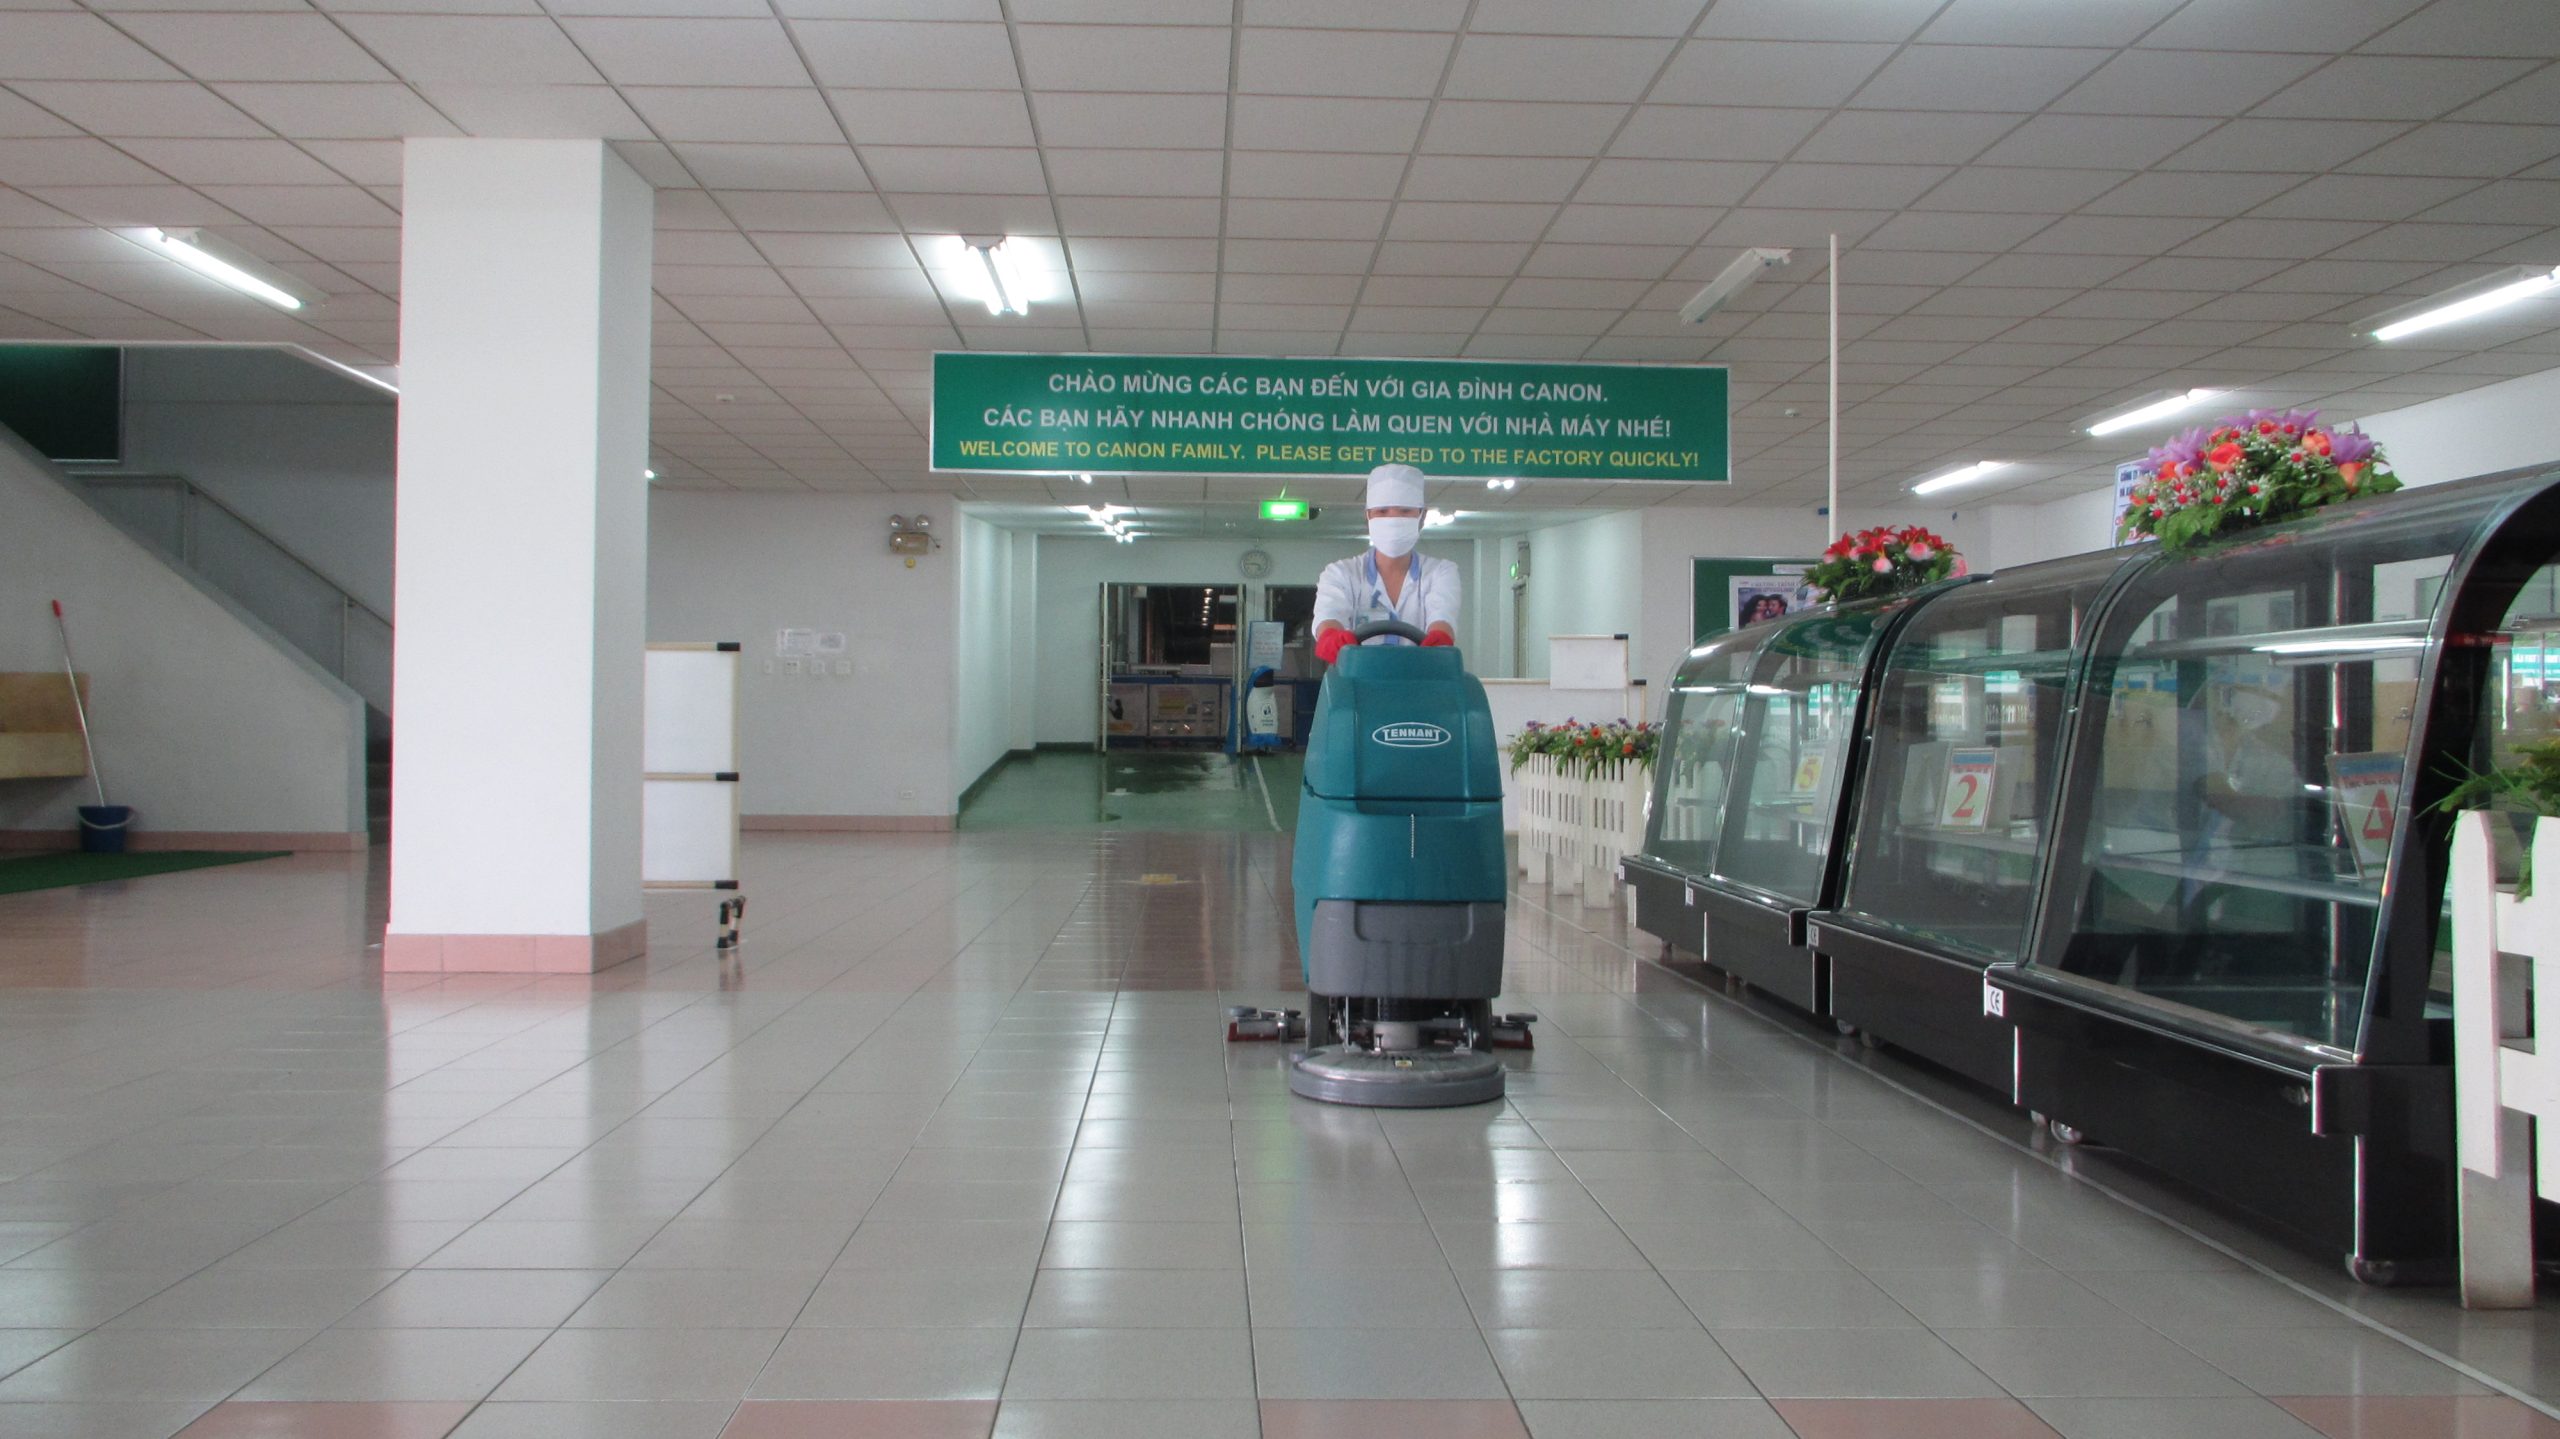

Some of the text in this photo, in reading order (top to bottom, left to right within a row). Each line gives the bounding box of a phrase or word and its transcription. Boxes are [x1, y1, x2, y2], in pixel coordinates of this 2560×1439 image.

[1048, 369, 1608, 402] CHÀO MỪNG CÁC BẠN ĐẾN VỚI GIA ĐÌNH CANON.
[984, 404, 1671, 438] CÁC BẠN HÃY NHANH CHÓNG LÀM QUEN VỚI NHÀ MÁY NHÉ!
[960, 440, 1699, 469] WELCOME TO CANON FAMILY. PLEASE GET USED TO THE FACTORY QUICKLY!
[1382, 728, 1440, 741] TENNANT
[1952, 774, 1977, 817] 2
[1990, 990, 2000, 1012] CE
